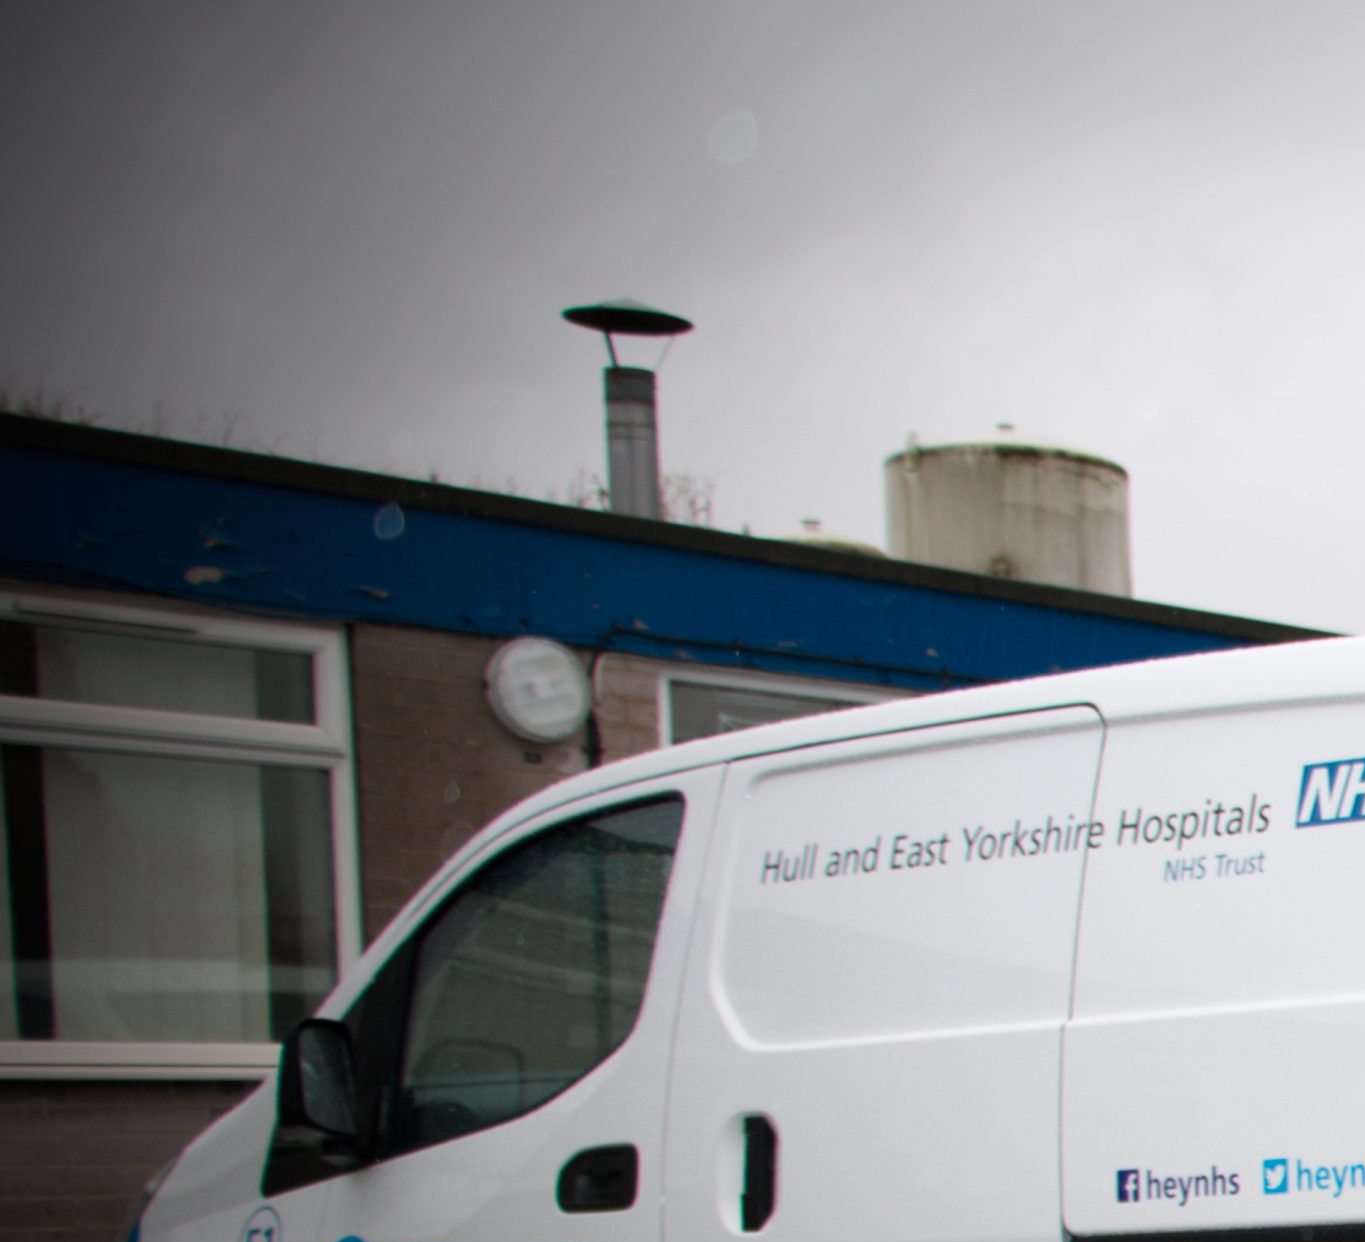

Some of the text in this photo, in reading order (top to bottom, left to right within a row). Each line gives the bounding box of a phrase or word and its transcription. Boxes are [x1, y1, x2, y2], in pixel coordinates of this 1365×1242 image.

[760, 794, 1271, 884] Hull and East Yorkshire Hospitals
[1163, 852, 1266, 884] NHS Trust
[1146, 1166, 1239, 1206] heynhs
